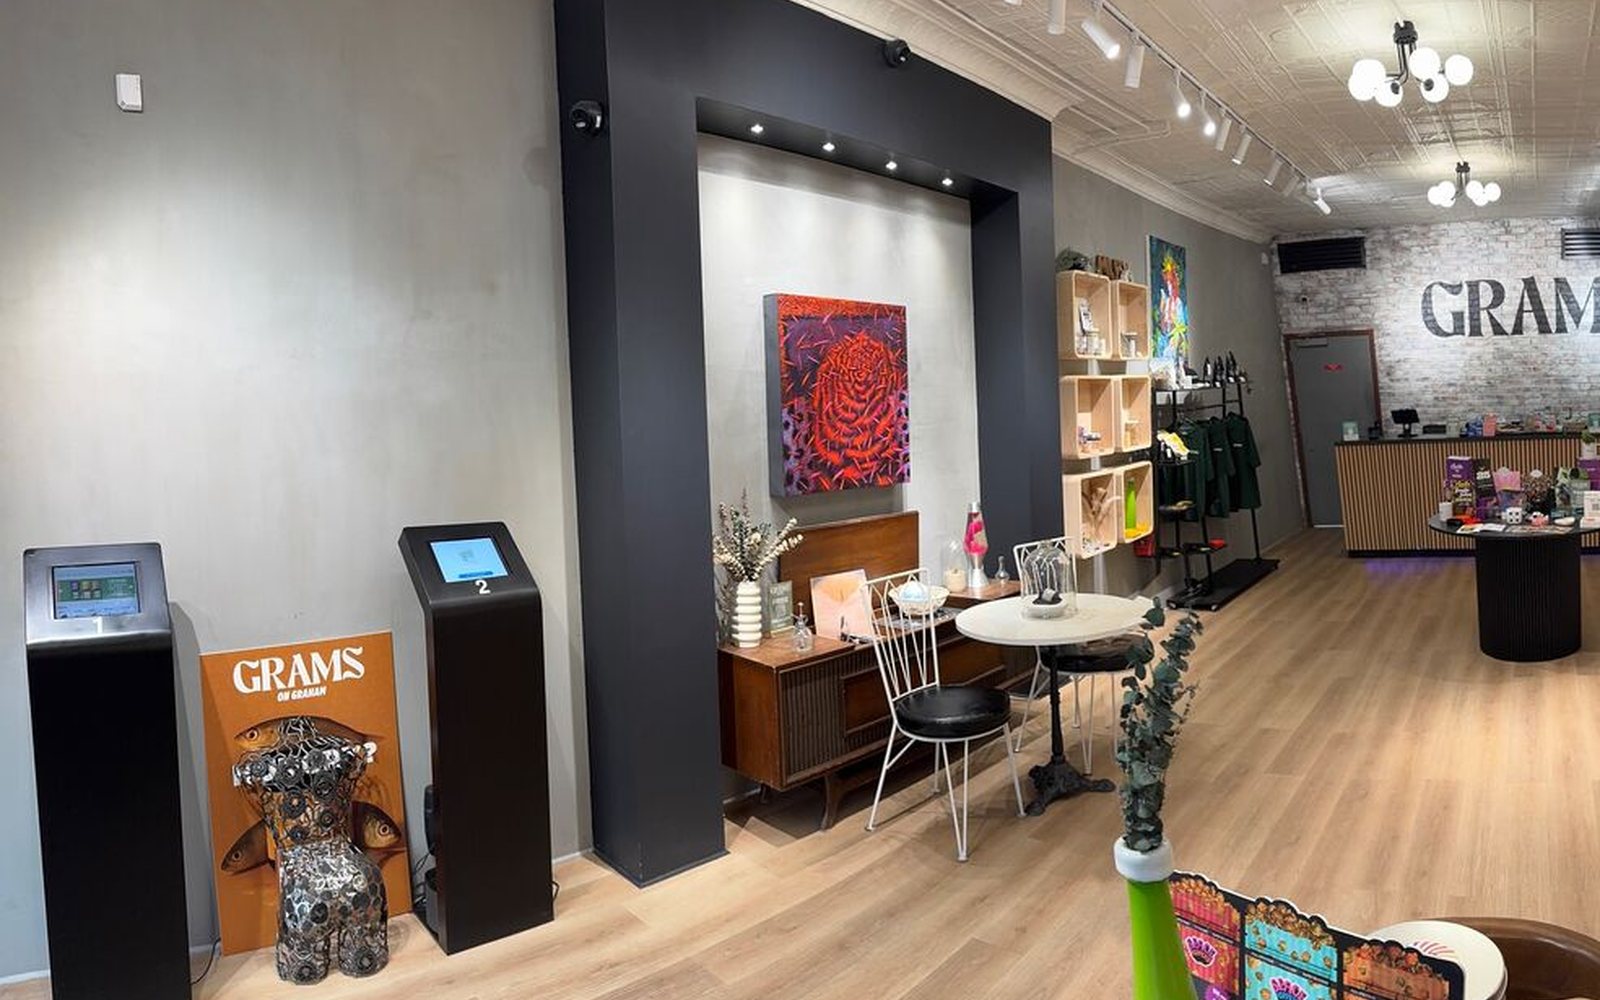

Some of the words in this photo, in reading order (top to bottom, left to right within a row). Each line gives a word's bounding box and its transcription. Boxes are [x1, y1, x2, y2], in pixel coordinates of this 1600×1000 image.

[1421, 275, 1600, 338] GRAM
[475, 579, 491, 595] 2
[93, 616, 104, 634] 1
[233, 646, 365, 694] GRAMS
[277, 691, 290, 702] ON
[291, 685, 328, 700] GRAHAM
